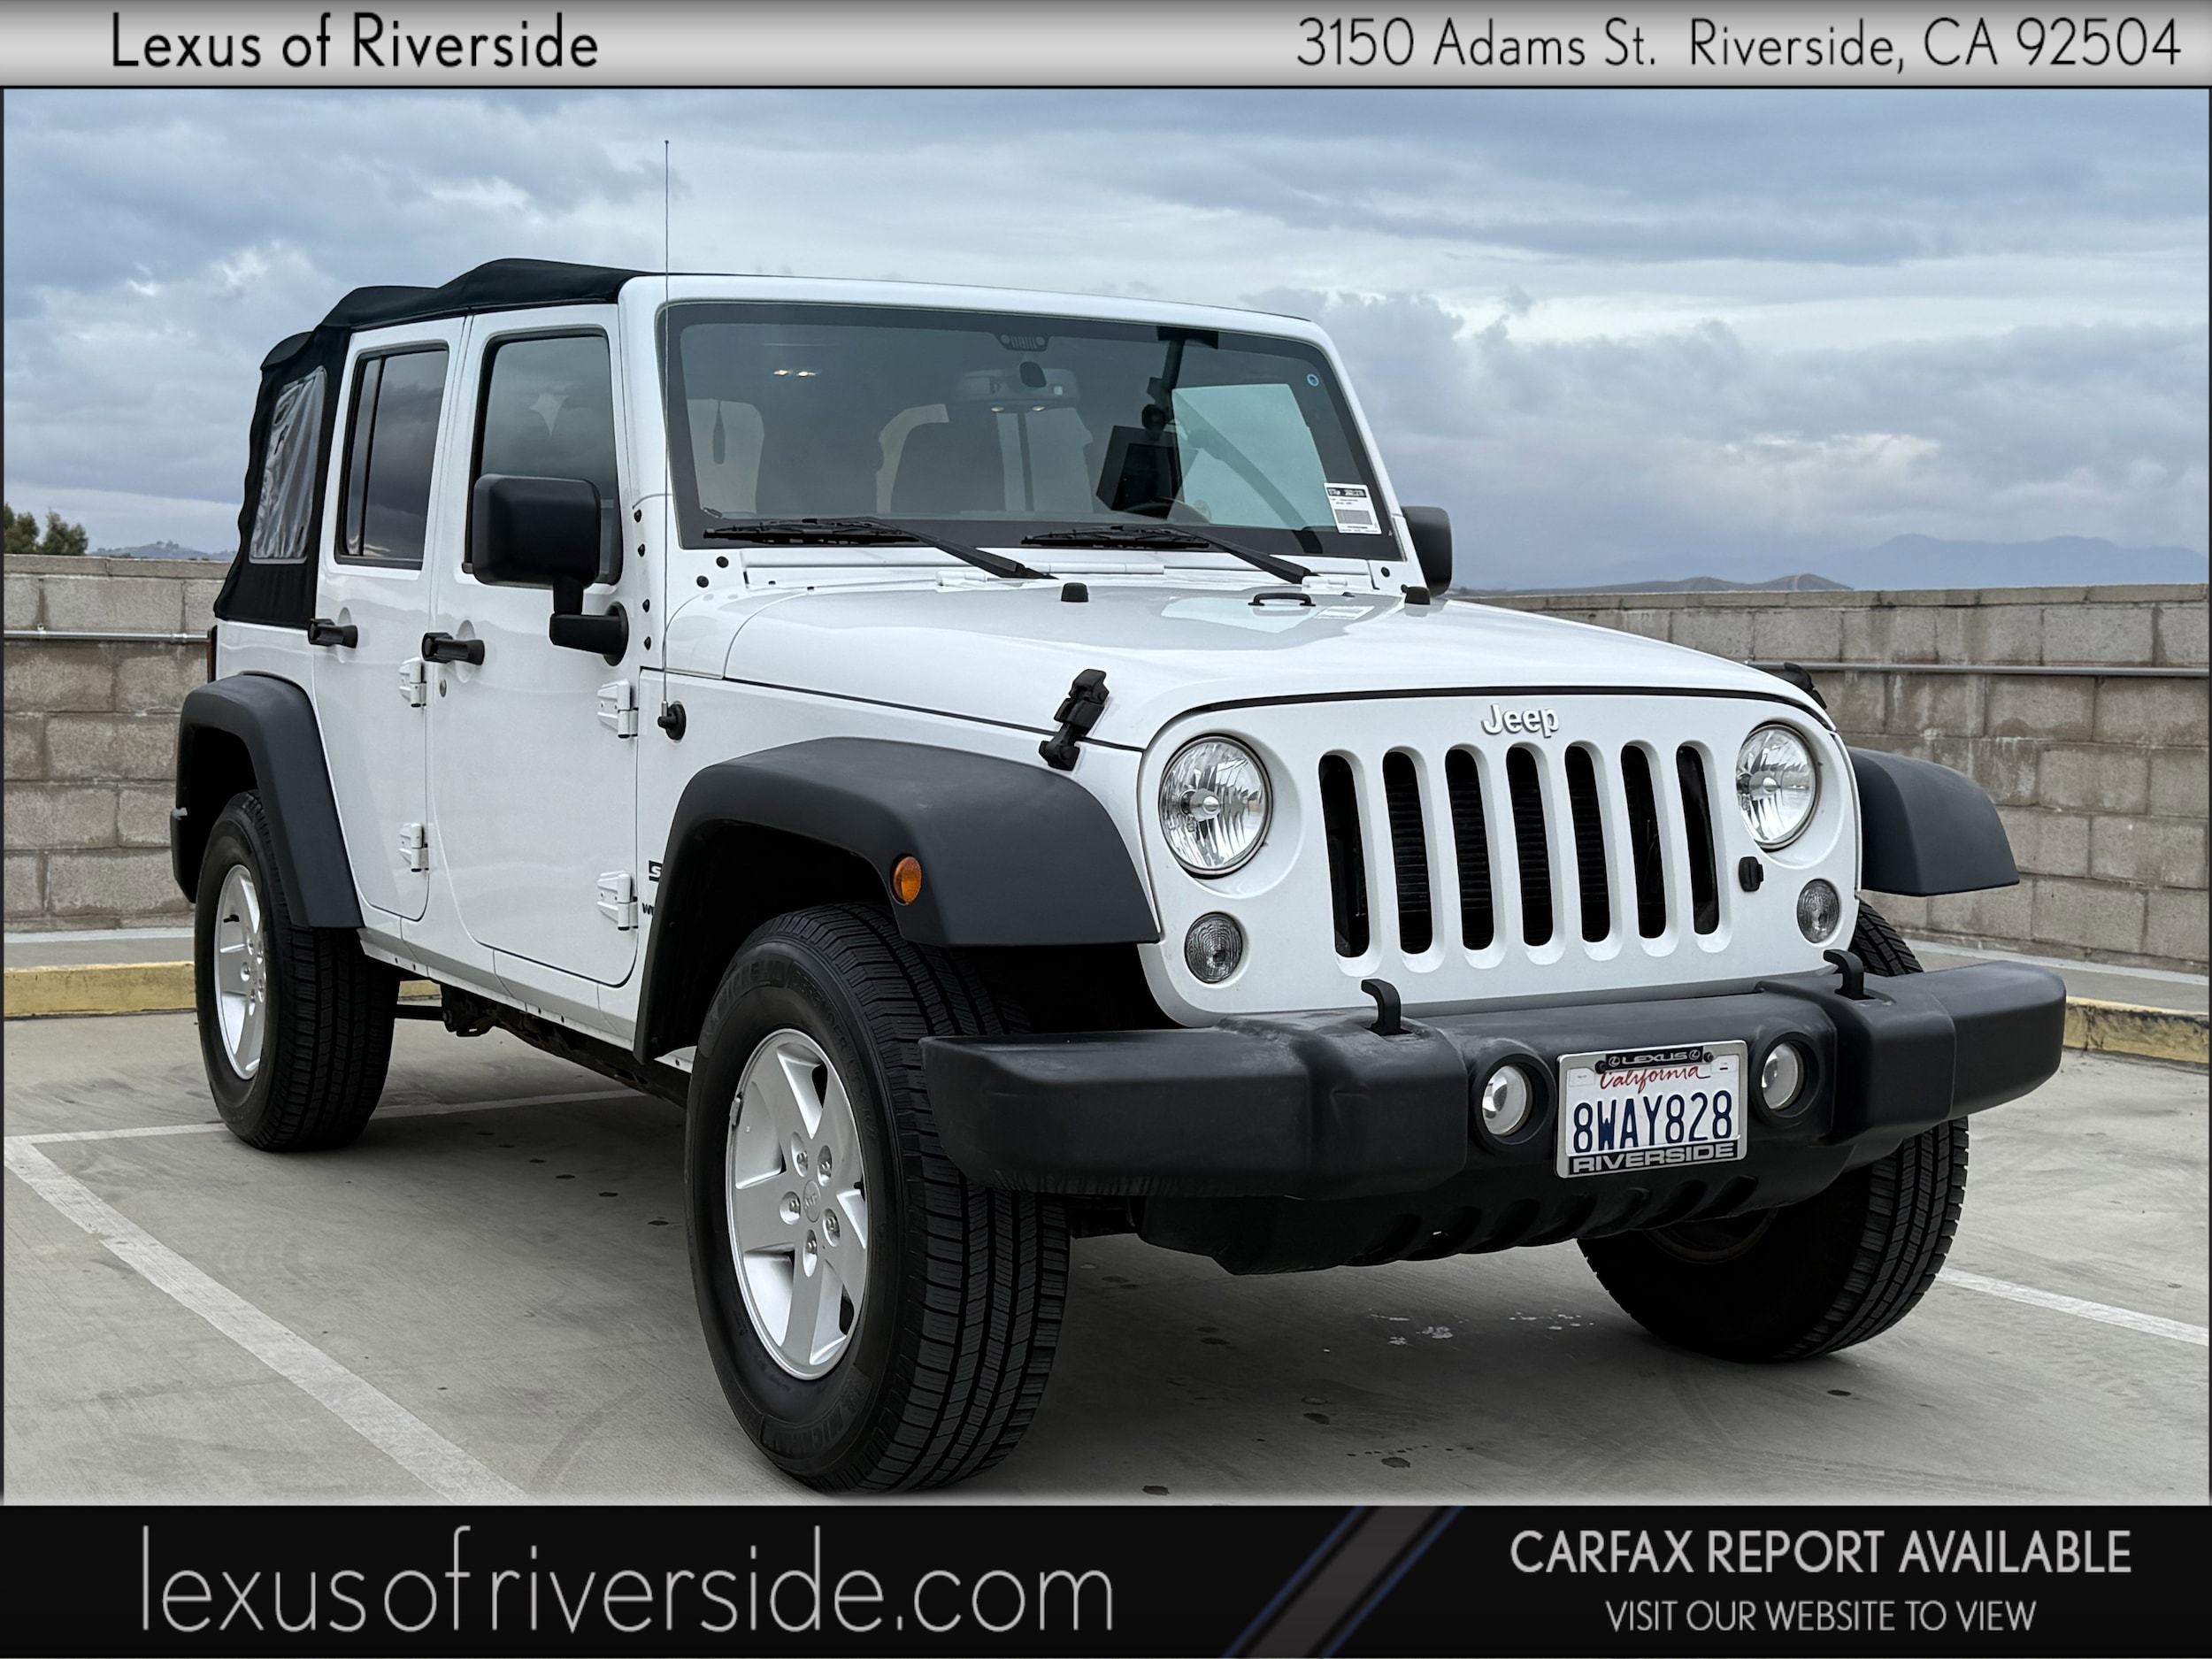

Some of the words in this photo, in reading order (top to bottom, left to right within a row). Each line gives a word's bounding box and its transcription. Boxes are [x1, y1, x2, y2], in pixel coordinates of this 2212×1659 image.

[1480, 703, 1560, 740] Jeep
[1621, 1050, 1687, 1065] LEXUS
[1600, 1065, 1711, 1094] California
[1572, 1089, 1733, 1155] 8WAY828
[1571, 1141, 1735, 1174] RIVERSIDE
